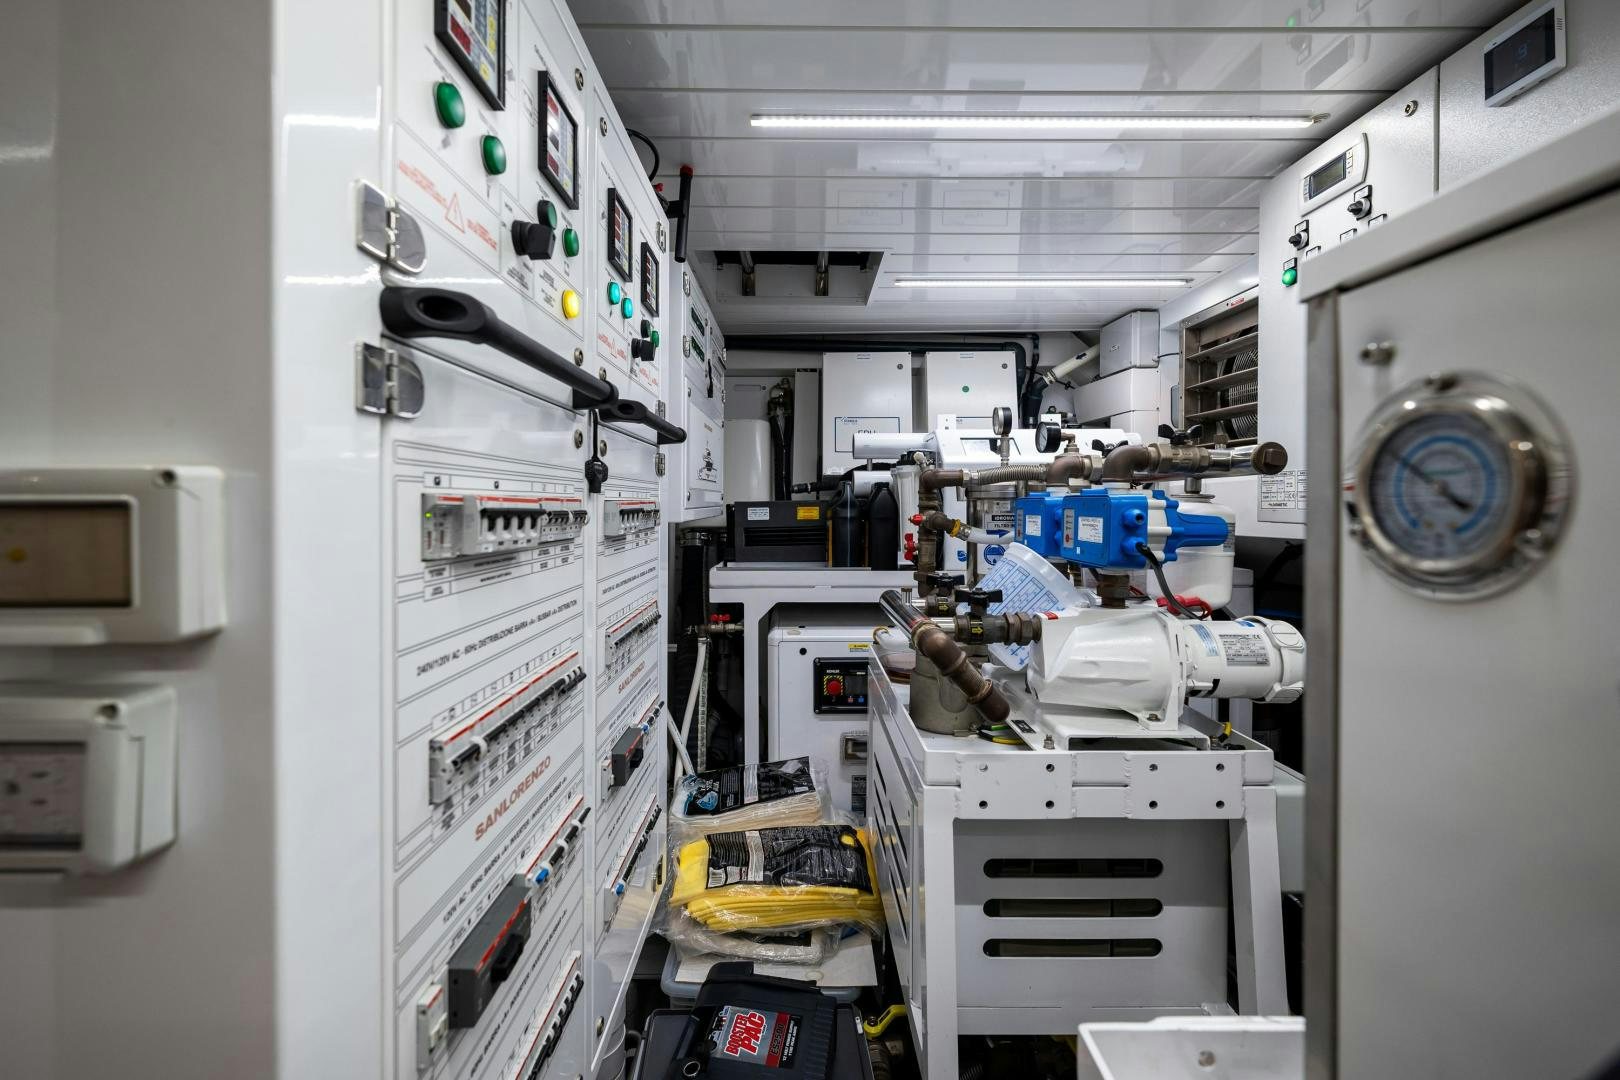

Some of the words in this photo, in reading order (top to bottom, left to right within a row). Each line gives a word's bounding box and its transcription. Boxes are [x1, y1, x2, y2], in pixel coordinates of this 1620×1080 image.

[475, 756, 551, 841] SANLORENZO
[724, 1013, 748, 1056] BOOSTER
[740, 1012, 766, 1054] PAC
[771, 1024, 785, 1055] ES2500
